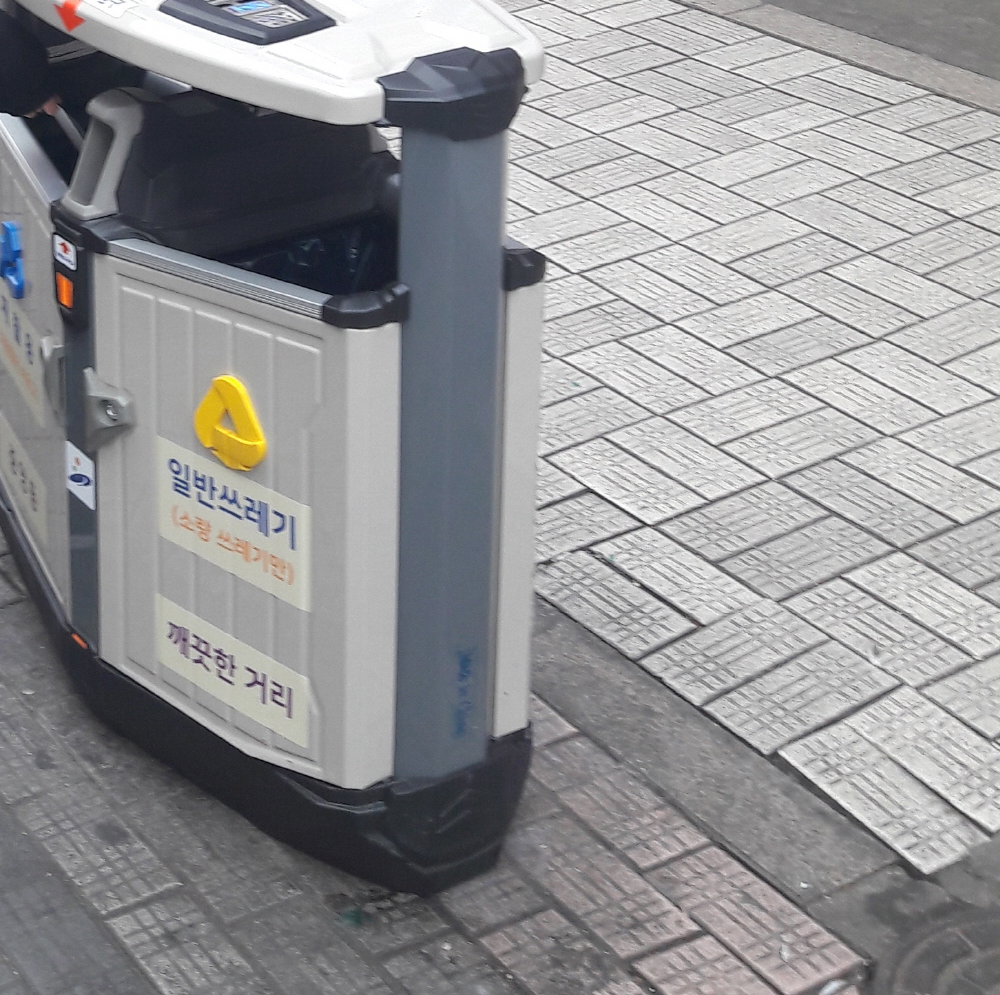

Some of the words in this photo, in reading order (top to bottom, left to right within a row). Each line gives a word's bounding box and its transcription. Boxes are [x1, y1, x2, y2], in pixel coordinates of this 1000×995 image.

[167, 458, 297, 551] 일반쓰레기
[215, 529, 296, 577] 쓰레기만)
[166, 620, 238, 686] 깨끗한
[243, 665, 295, 720] 거리
